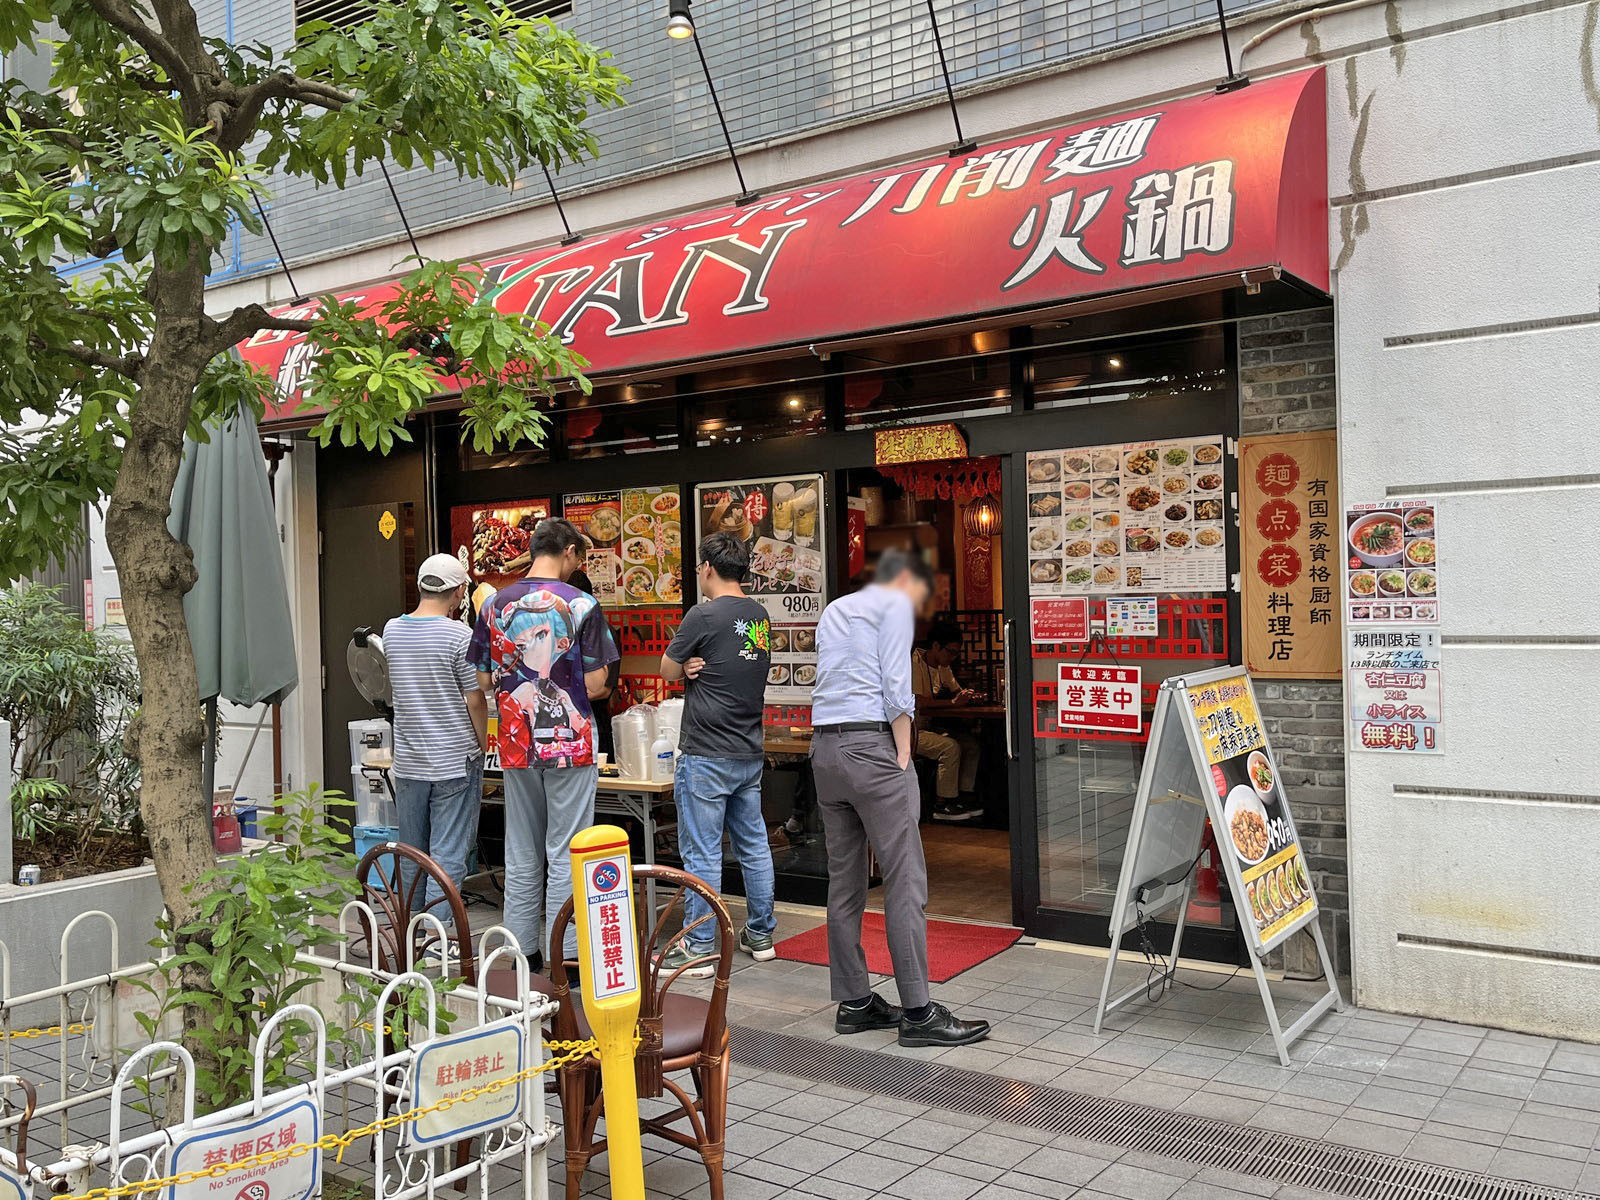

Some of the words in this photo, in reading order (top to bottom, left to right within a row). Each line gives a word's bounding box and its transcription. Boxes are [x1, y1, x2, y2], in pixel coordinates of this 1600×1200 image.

[840, 111, 1166, 228] 刀削麺
[625, 188, 843, 250] シーアン
[1002, 158, 1236, 290] 火鍋
[745, 492, 768, 520] 得
[1307, 478, 1332, 626] 有国家資格厨師
[782, 595, 819, 612] 980円
[1353, 632, 1433, 648] 期間限定！
[1350, 660, 1440, 669] 13時以降のご来店で
[1366, 650, 1424, 660] ランチタイム
[1071, 668, 1127, 681] 歓迎光臨
[1365, 671, 1426, 689] 杏仁豆腐
[1066, 685, 1133, 710] 営業中
[1384, 689, 1408, 700] 又は
[1064, 713, 1085, 722] 営業時間
[1366, 703, 1427, 720] 小ライス
[1361, 721, 1436, 750] 無料！
[590, 896, 599, 904] NO
[600, 891, 627, 901] PARKING
[600, 902, 625, 990] 駐輪禁止
[436, 1051, 505, 1087] 駐輪禁止
[203, 1122, 297, 1170] 禁煙区域
[208, 1180, 223, 1191] No
[226, 1165, 268, 1186] Smoking
[269, 1157, 289, 1171] Area
